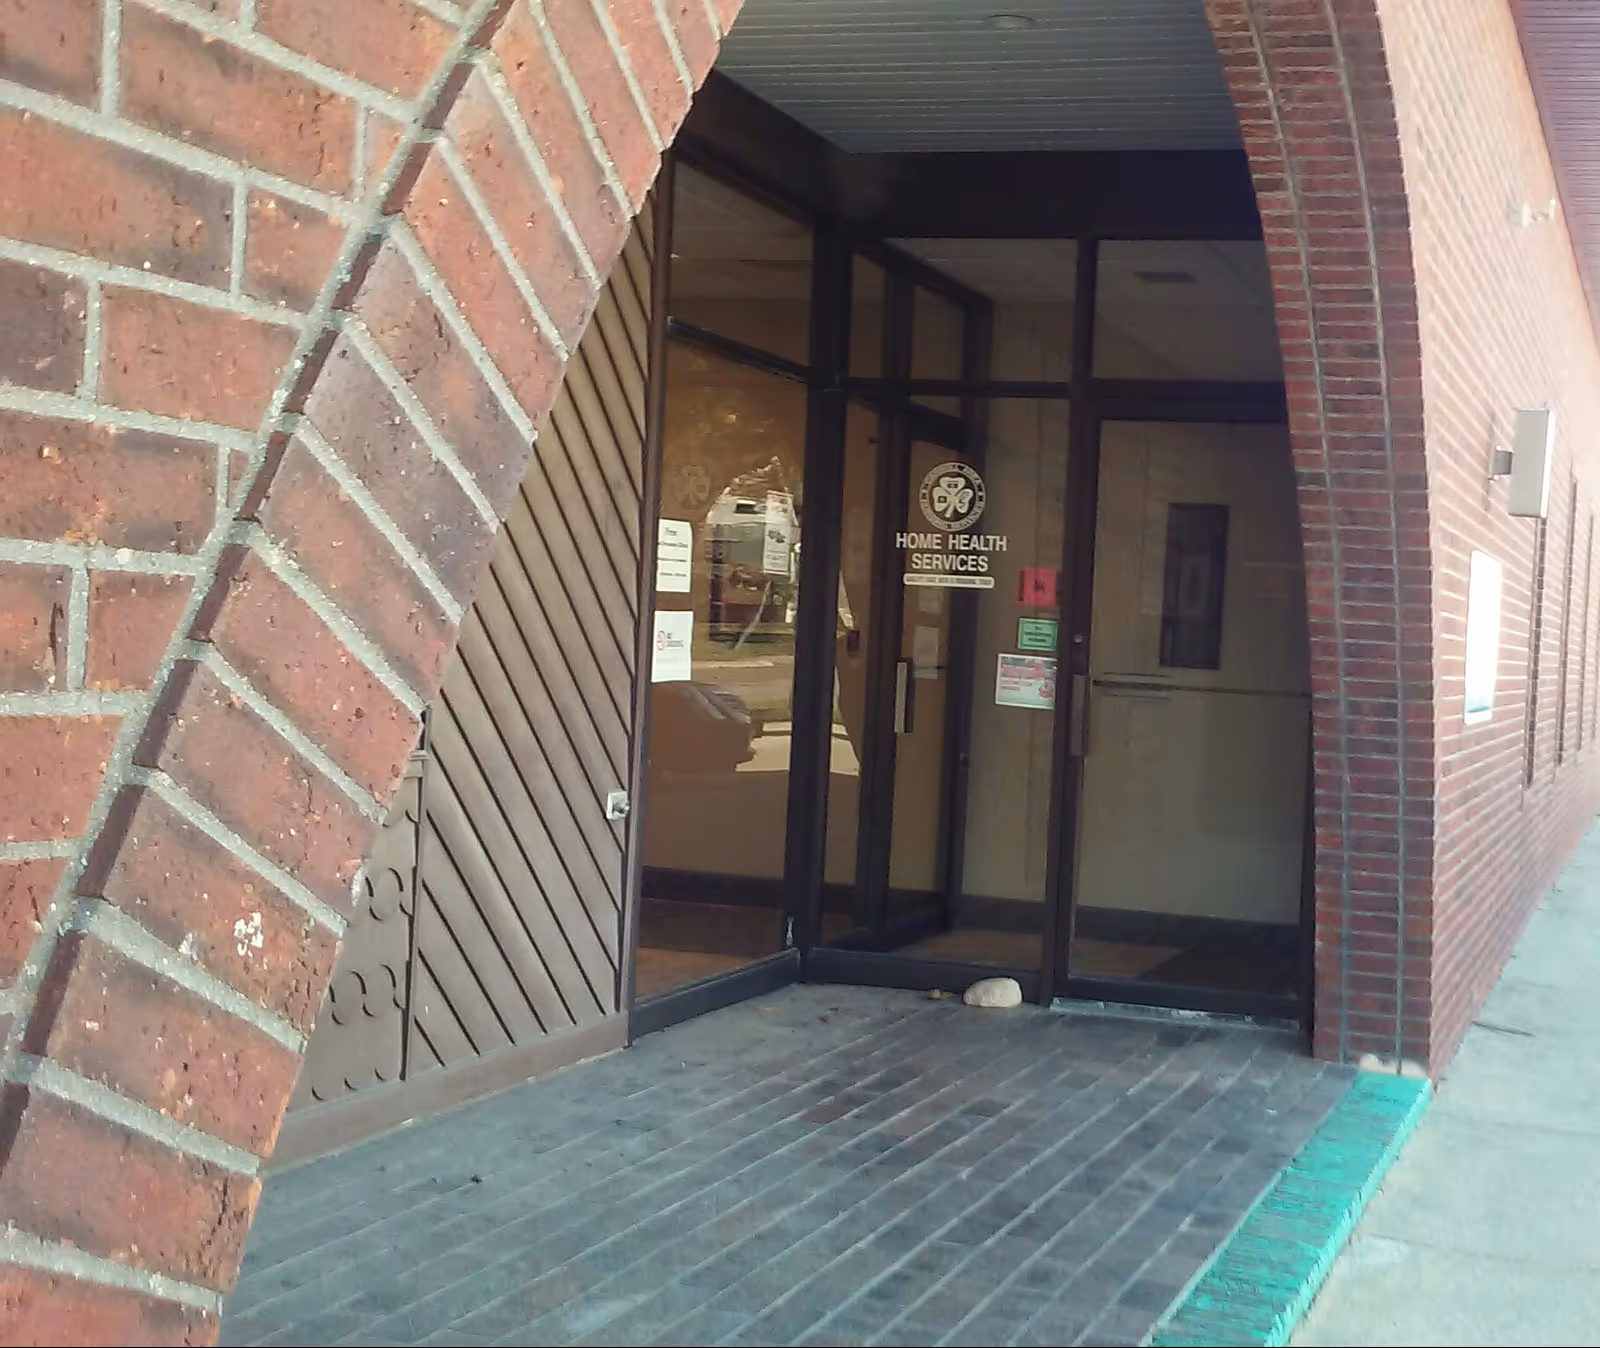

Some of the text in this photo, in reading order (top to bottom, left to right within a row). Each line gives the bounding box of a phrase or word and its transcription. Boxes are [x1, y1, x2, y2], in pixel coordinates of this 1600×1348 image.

[896, 532, 1007, 551] HOME HEALTH
[911, 553, 988, 572] SERVICES
